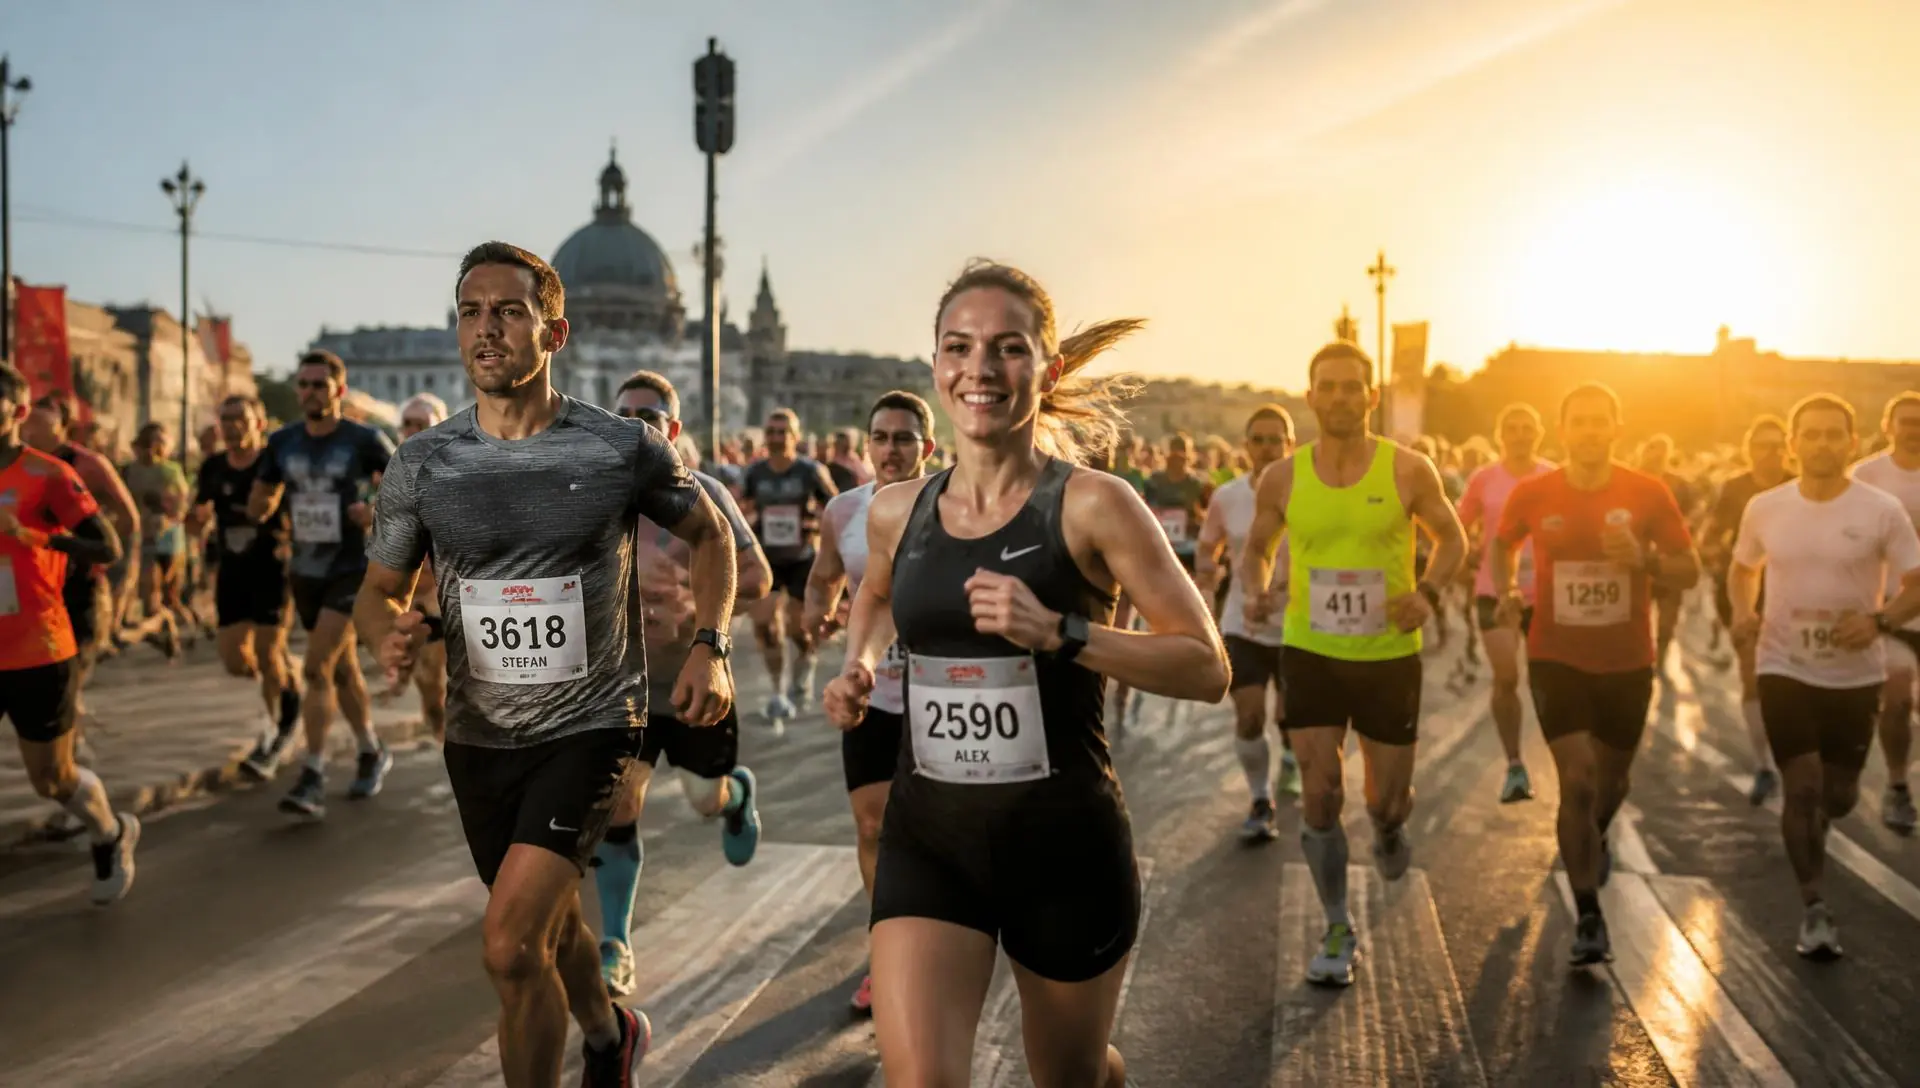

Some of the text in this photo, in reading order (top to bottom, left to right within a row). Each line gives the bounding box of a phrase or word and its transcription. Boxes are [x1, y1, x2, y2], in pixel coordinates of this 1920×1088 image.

[1326, 592, 1367, 615] 411
[1566, 582, 1619, 606] 1259
[480, 615, 566, 650] 3618
[502, 656, 548, 668] STEFAN
[925, 701, 1019, 741] 2590
[954, 750, 990, 763] ALEX
